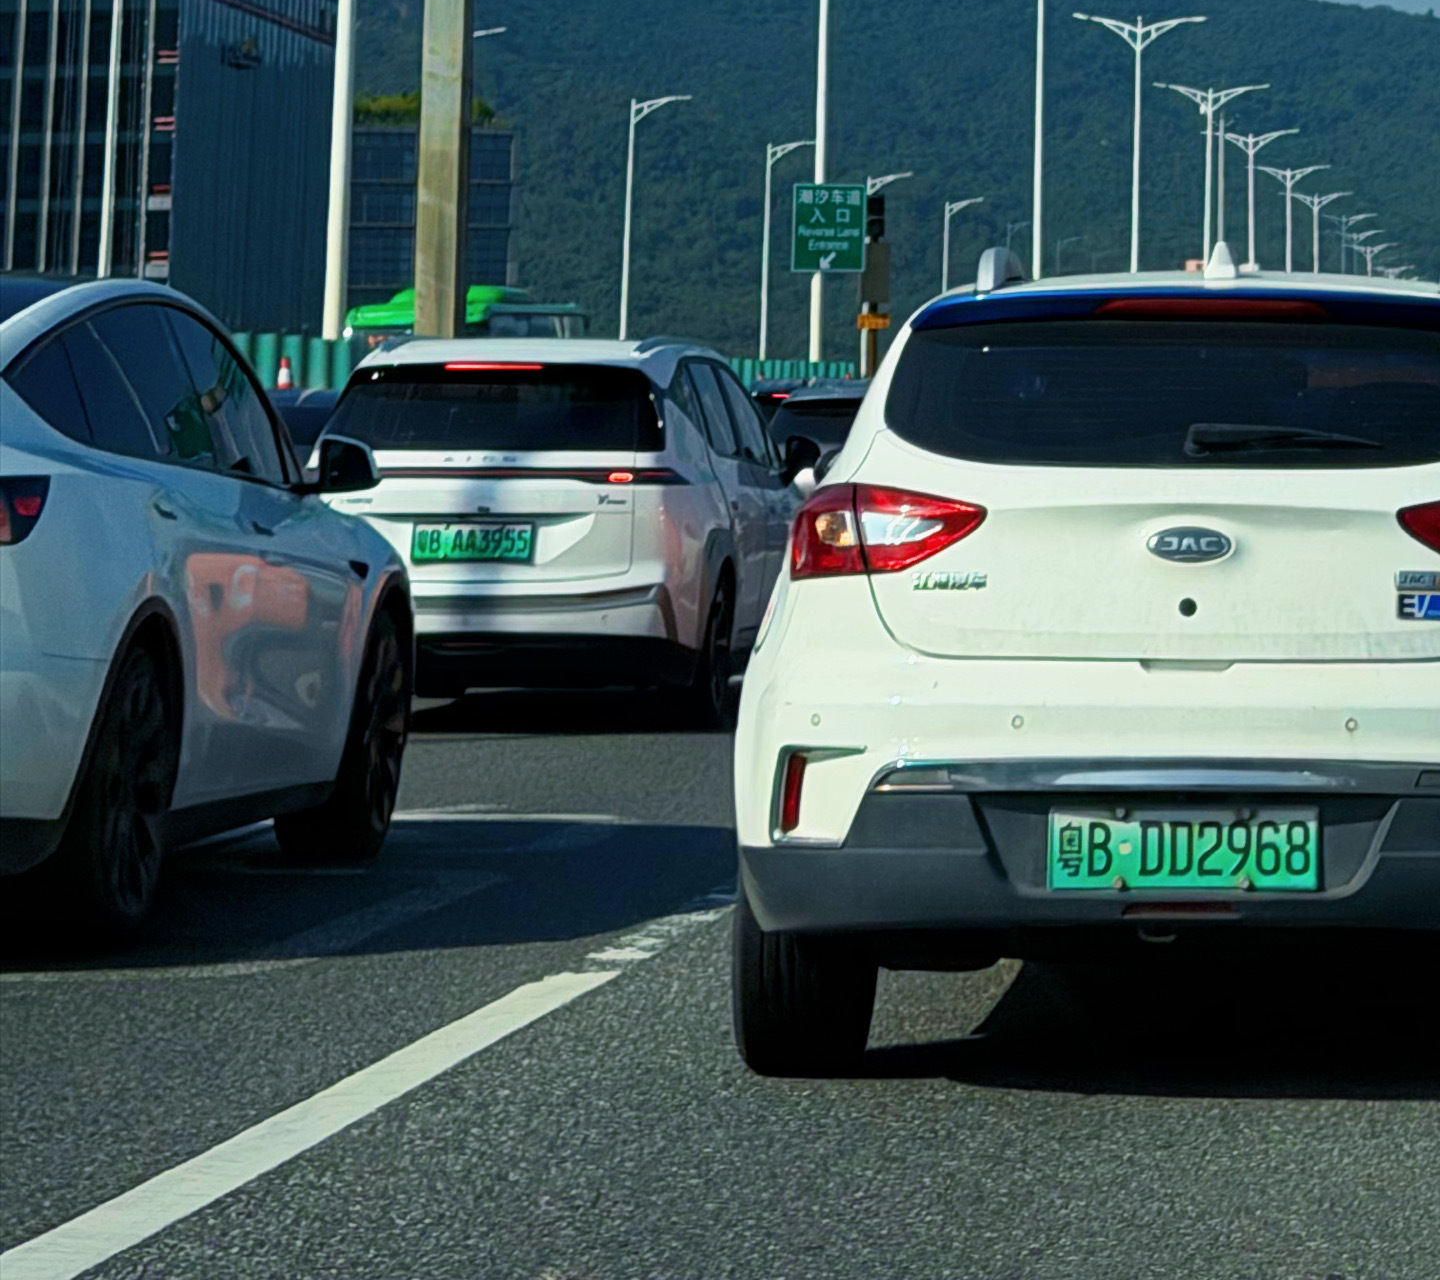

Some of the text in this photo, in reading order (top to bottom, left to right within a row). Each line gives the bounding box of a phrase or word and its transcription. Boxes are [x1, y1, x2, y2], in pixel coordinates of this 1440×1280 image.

[798, 189, 861, 205] 潮汐车道
[809, 208, 850, 223] 入口
[1159, 537, 1218, 552] JAC
